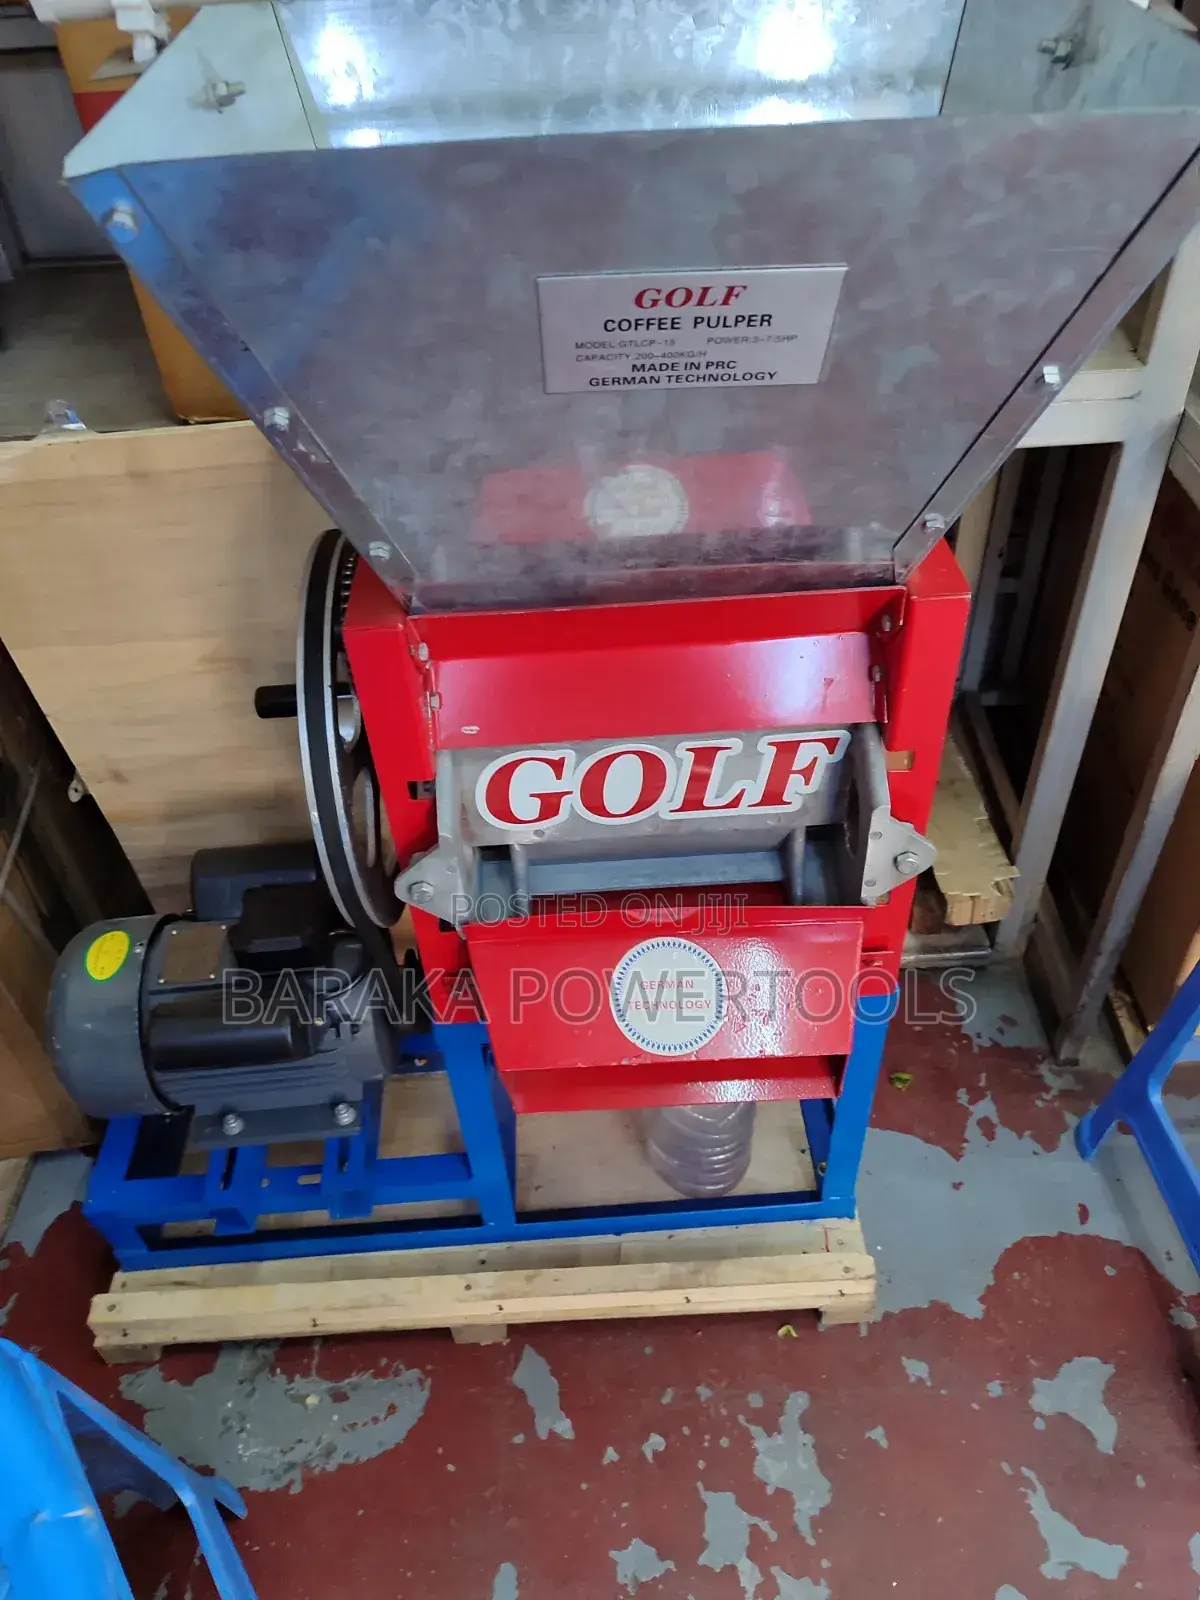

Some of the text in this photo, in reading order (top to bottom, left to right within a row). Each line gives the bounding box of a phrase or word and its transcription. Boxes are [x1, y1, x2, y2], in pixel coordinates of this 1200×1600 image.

[634, 285, 748, 309] GOLF
[603, 313, 773, 333] COFFEE PULPER
[631, 360, 737, 373] MADE IN PRC
[588, 370, 778, 387] GERMAN TECHNOLOGY
[481, 733, 845, 827] GOLF
[640, 979, 694, 990] GERMAN
[627, 999, 712, 1011] TECHNOLOGY
